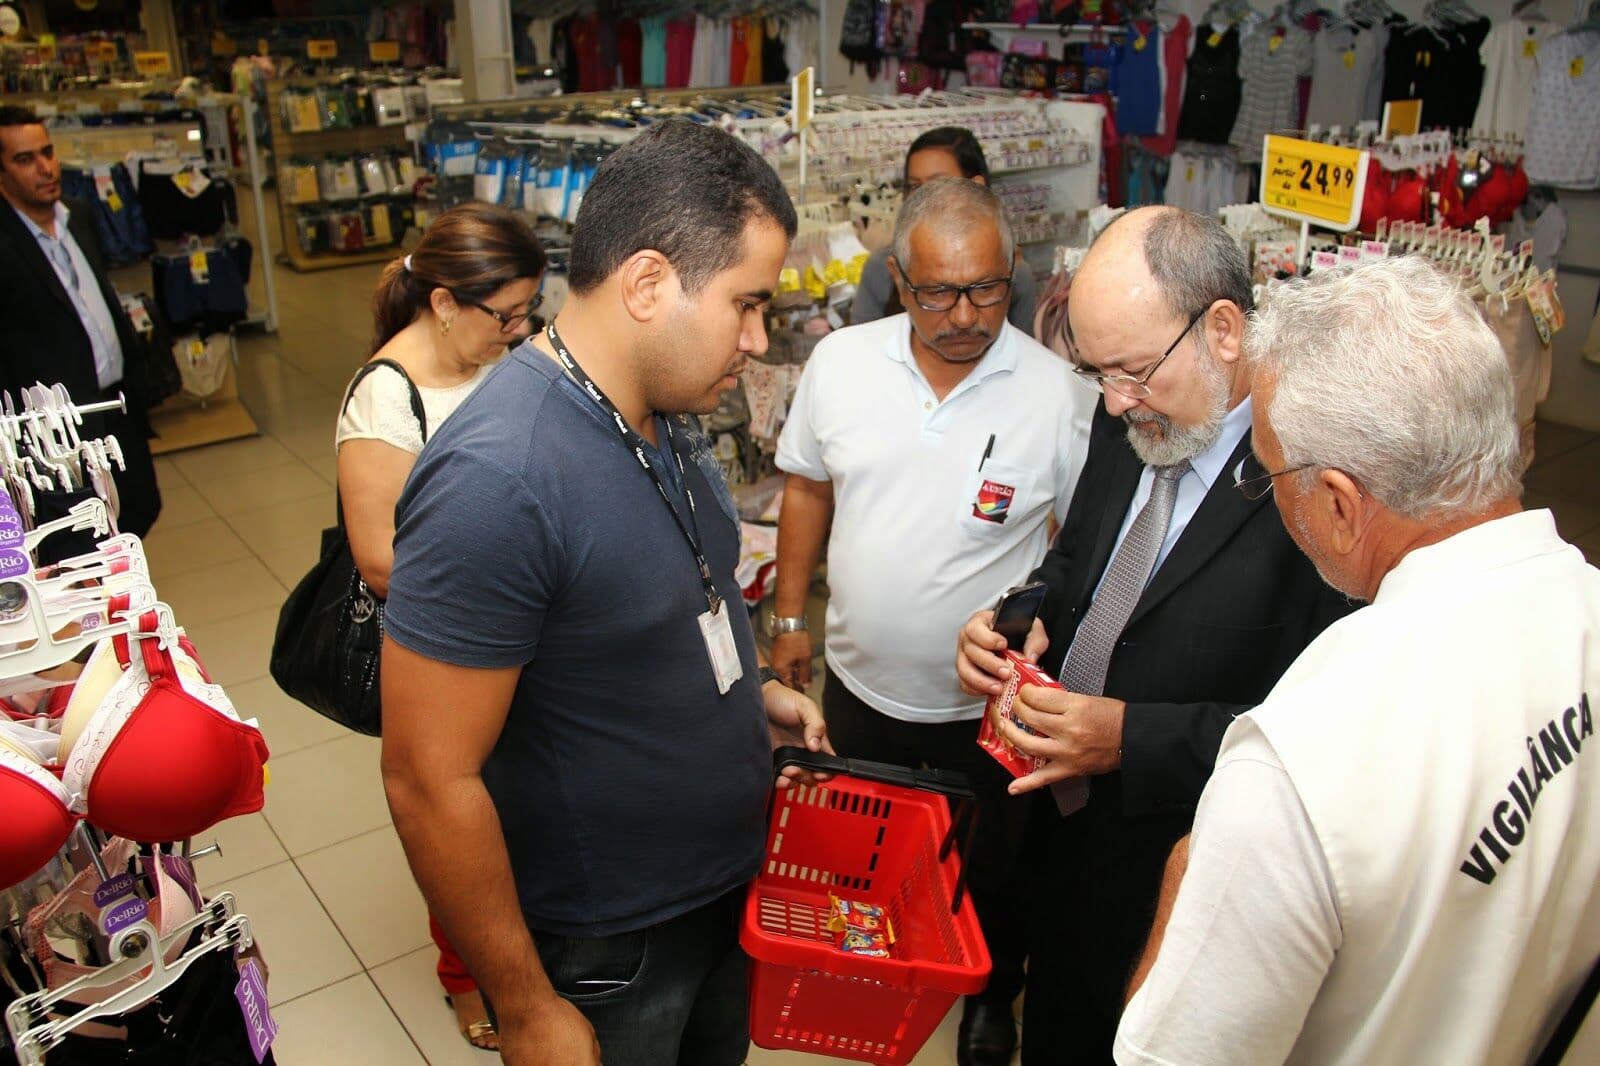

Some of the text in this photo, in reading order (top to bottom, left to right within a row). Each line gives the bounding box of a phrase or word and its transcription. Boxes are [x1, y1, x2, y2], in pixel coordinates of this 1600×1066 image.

[1460, 691, 1594, 886] VIGILÂNCA
[107, 904, 145, 927] DelRio
[242, 979, 270, 1052] DelRio
